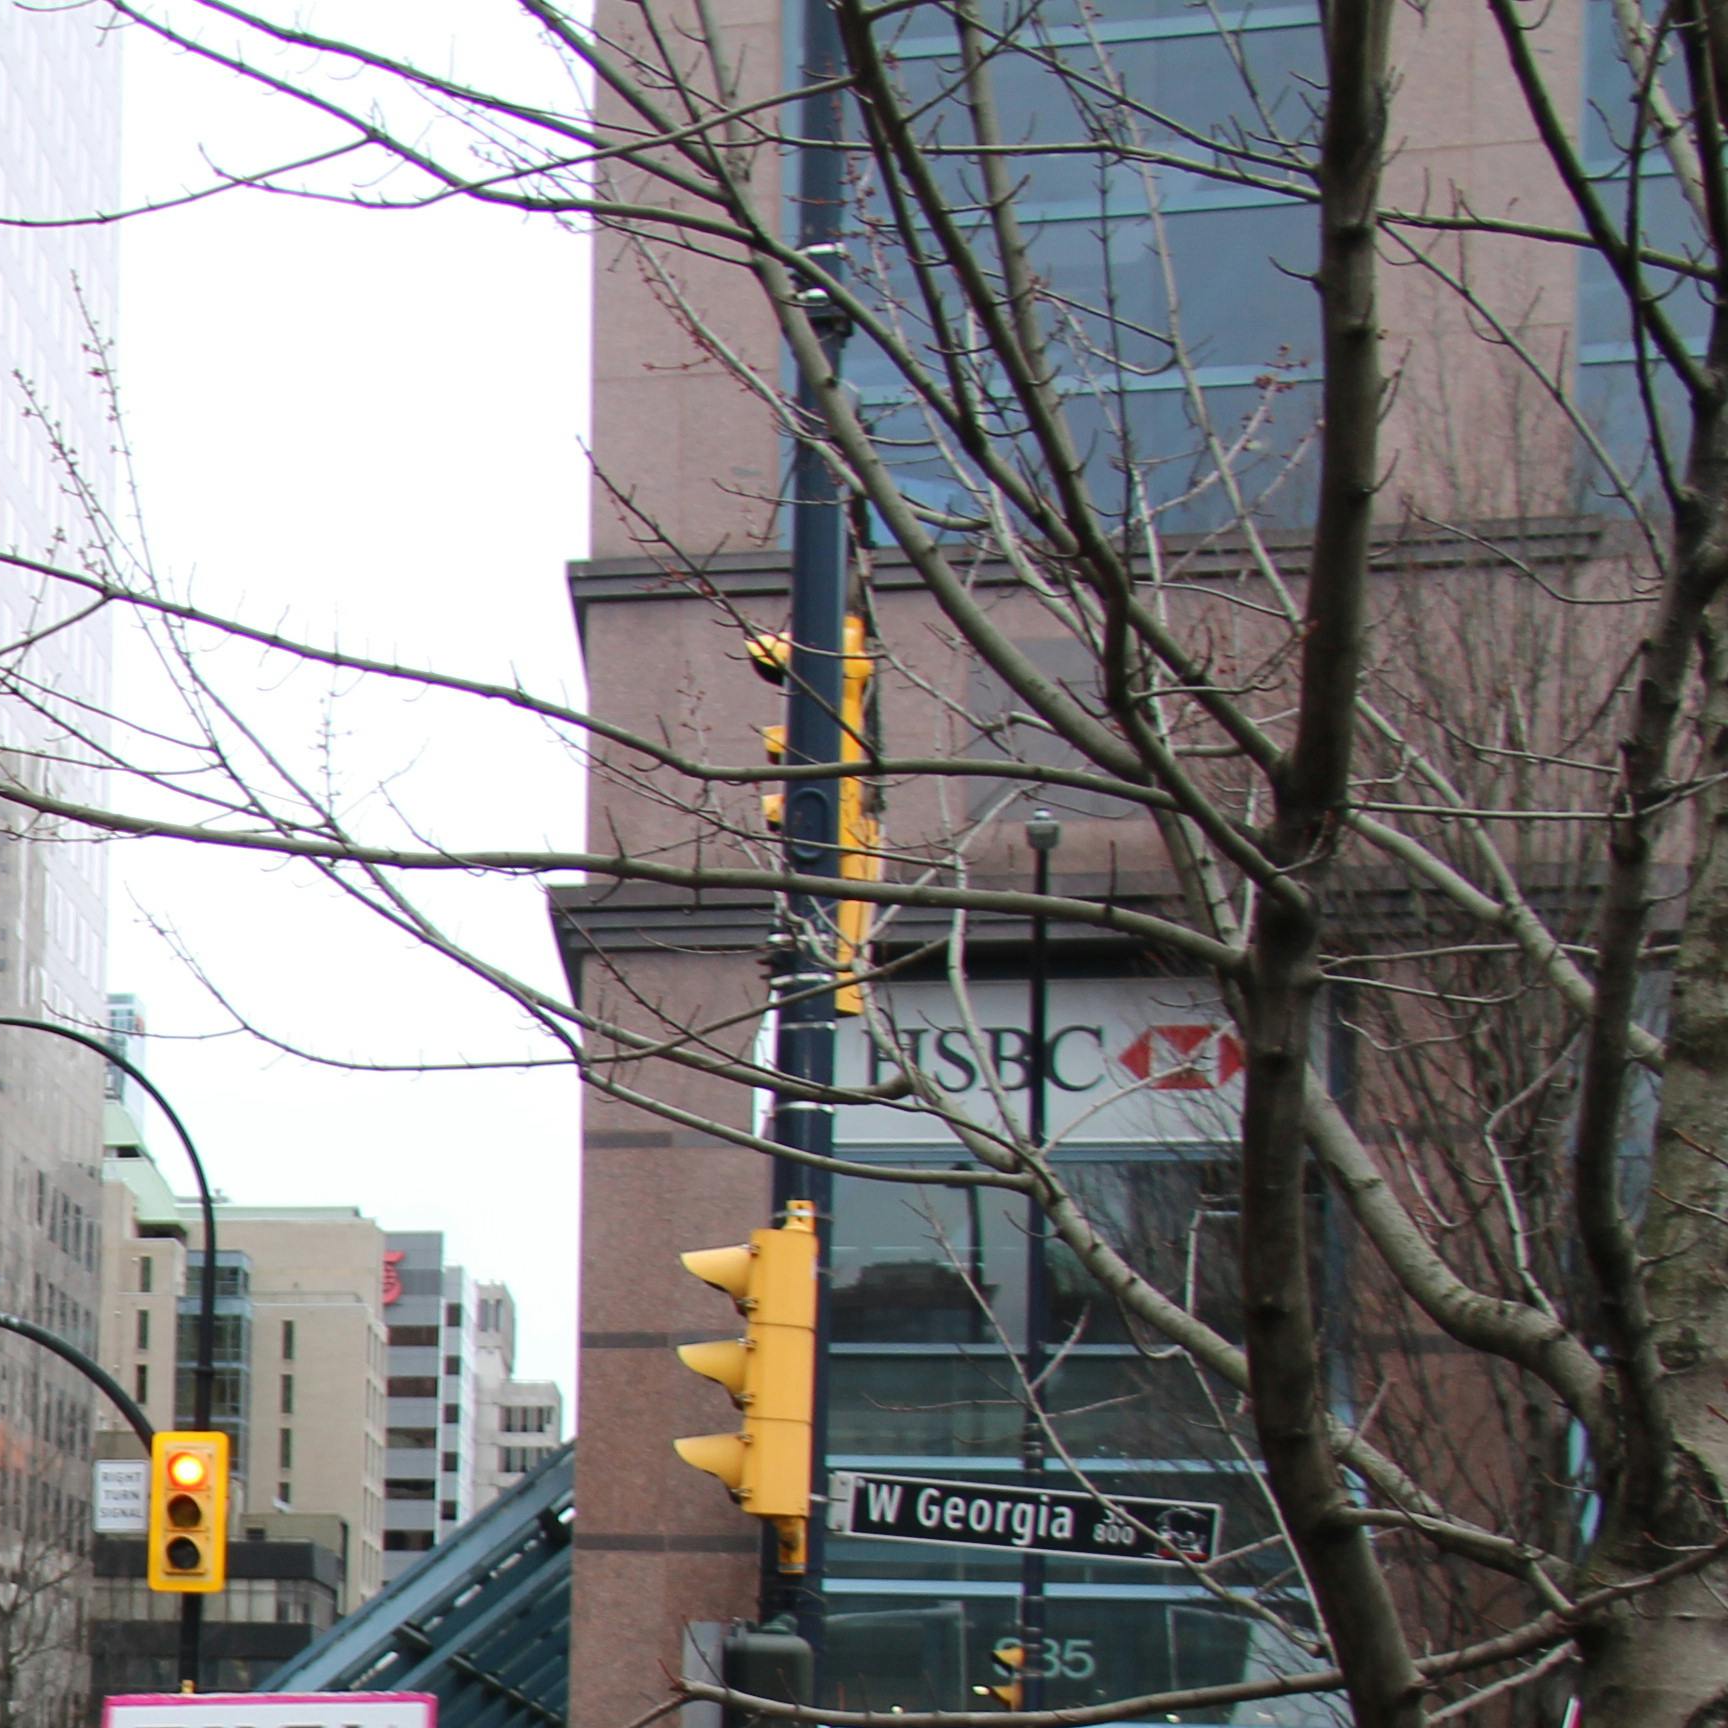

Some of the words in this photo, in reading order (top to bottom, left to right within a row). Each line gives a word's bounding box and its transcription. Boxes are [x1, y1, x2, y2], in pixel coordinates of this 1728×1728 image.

[861, 1025, 1104, 1093] HSBC
[866, 1484, 903, 1524] W
[915, 1486, 1075, 1547] Georgia
[1093, 1523, 1136, 1546] 800
